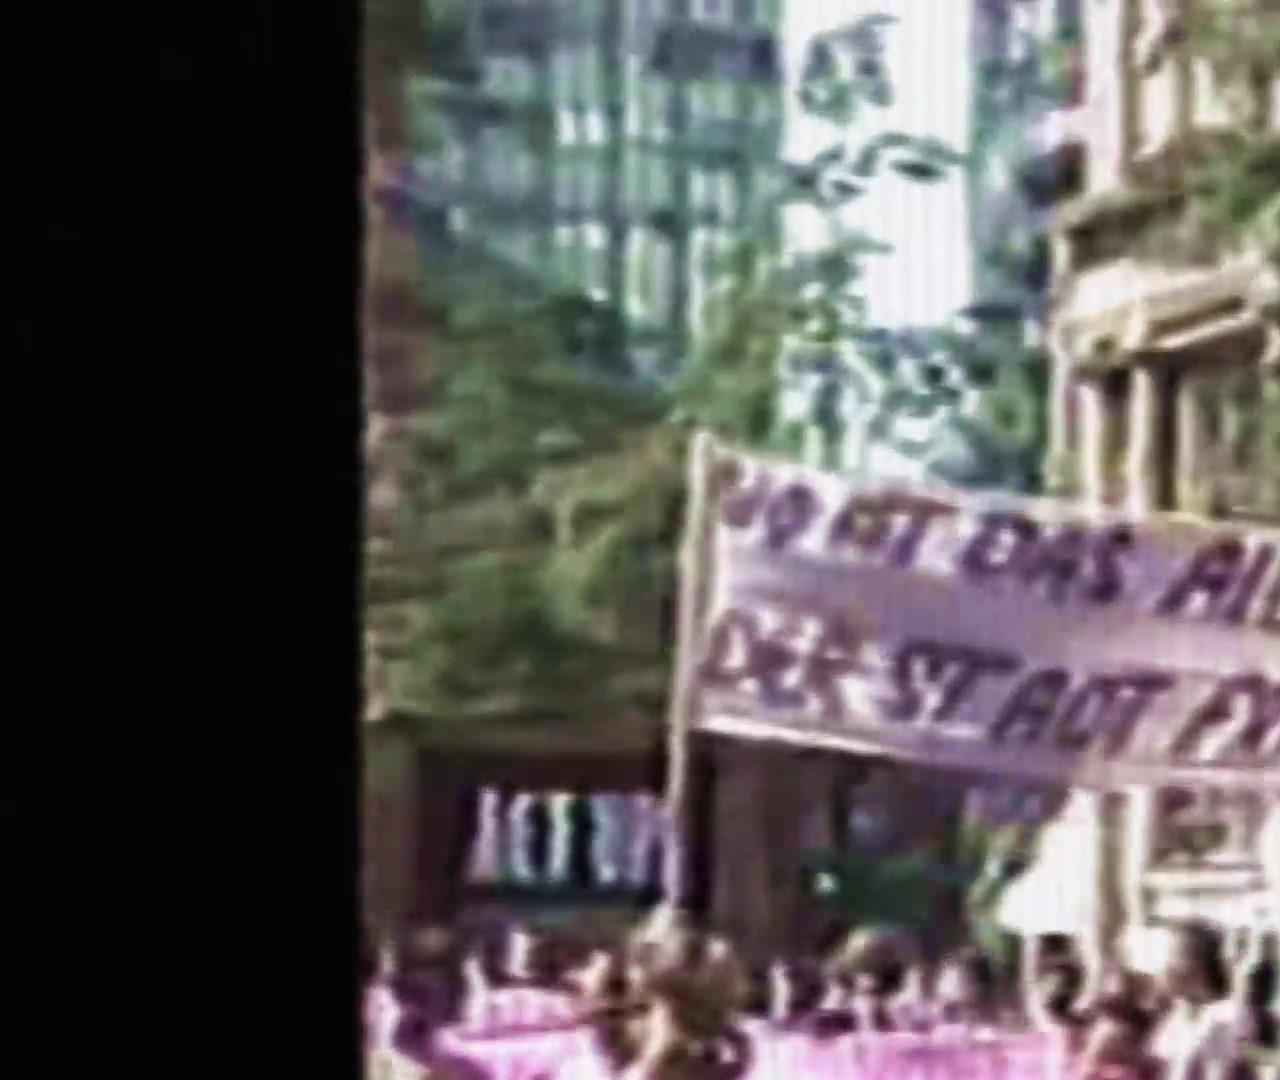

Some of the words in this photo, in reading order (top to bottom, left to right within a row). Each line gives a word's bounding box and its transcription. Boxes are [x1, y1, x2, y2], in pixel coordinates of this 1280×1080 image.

[958, 508, 1136, 606] DAS
[696, 606, 884, 720] DER
[880, 640, 1178, 762] STADT
